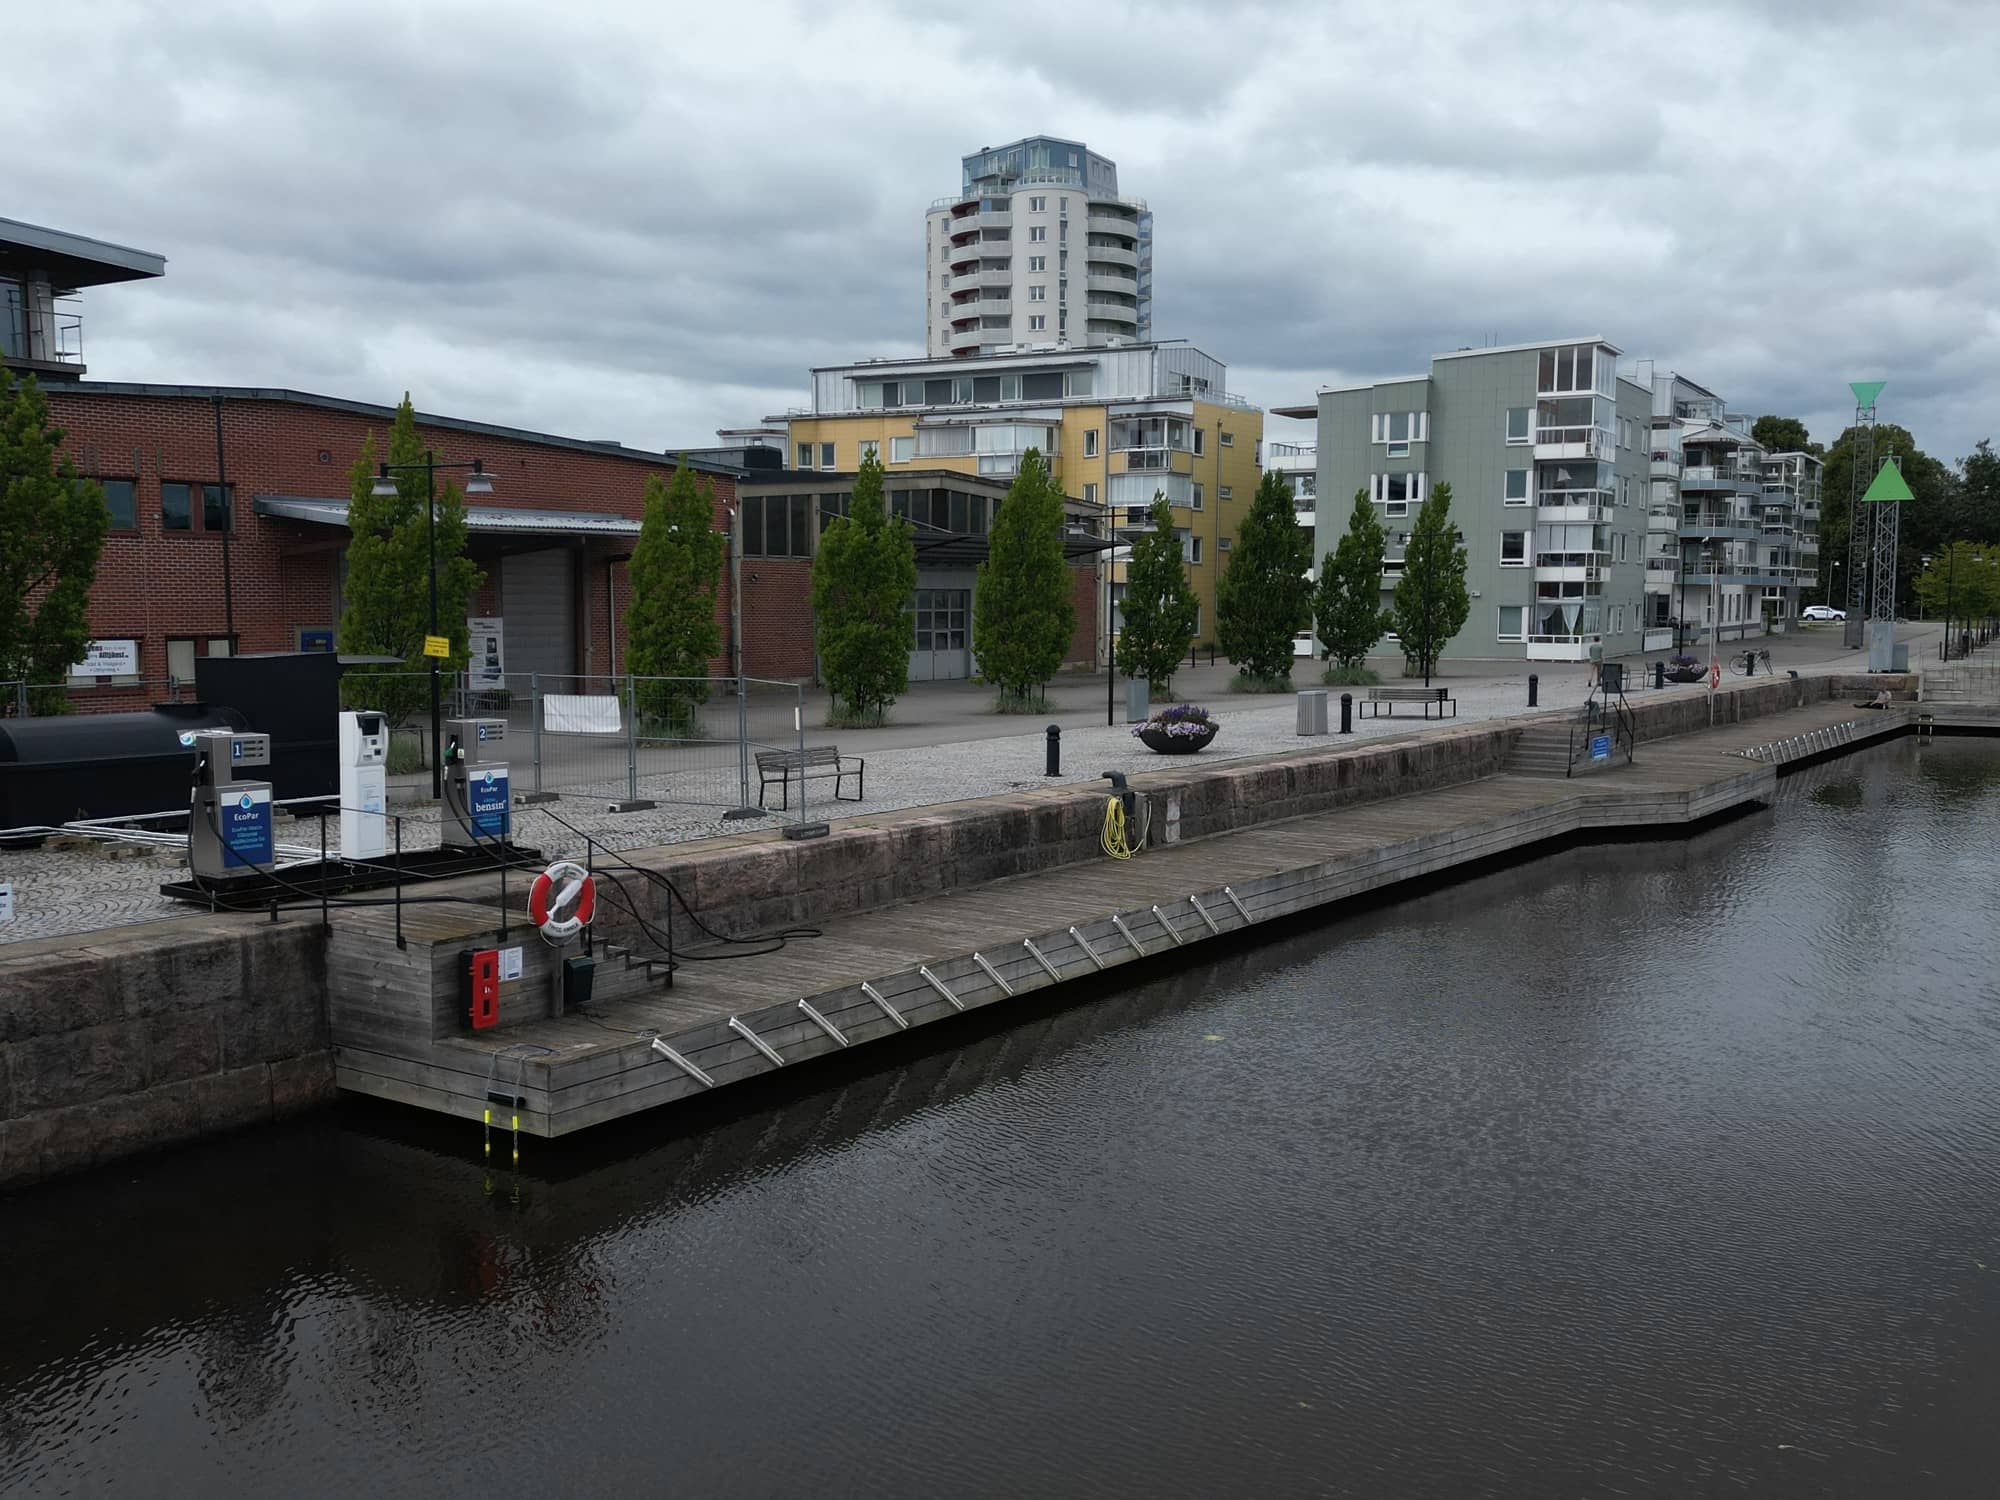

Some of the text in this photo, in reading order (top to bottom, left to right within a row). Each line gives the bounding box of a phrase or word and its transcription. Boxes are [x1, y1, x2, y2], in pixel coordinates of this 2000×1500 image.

[479, 728, 486, 738] 2
[234, 744, 241, 756] 1
[475, 801, 505, 812] bensin
[234, 812, 259, 821] EcoPar
